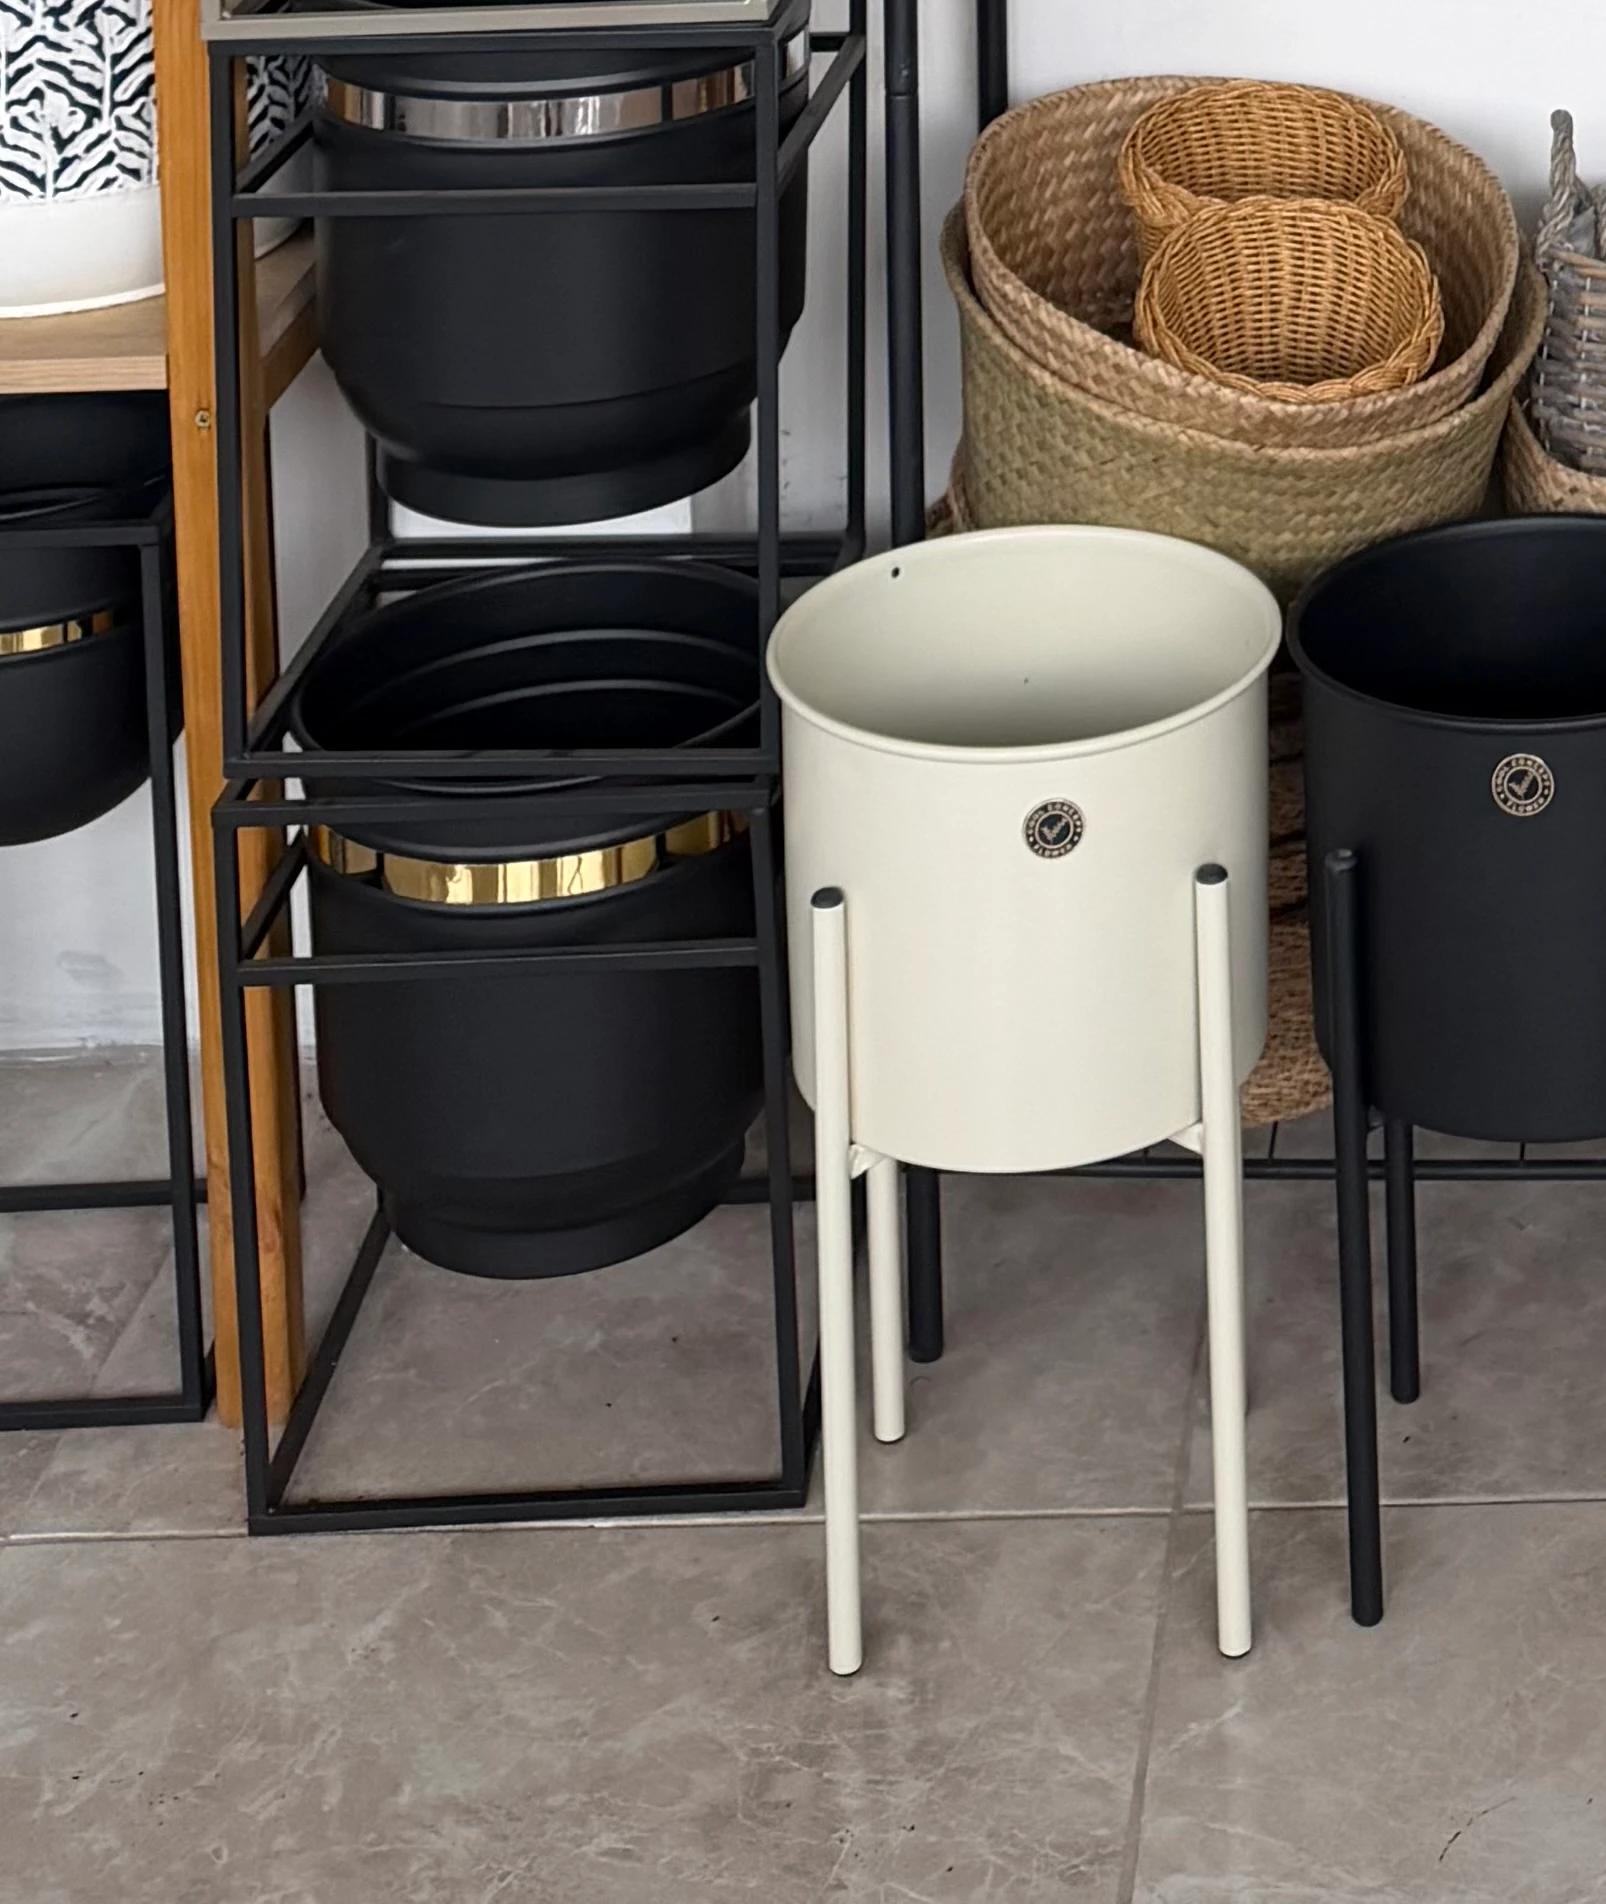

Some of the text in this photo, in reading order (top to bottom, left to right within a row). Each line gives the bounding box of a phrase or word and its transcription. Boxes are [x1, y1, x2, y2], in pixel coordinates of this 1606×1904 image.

[1511, 758, 1550, 786] CONCEPT
[1506, 797, 1544, 812] FLOWER
[1047, 803, 1082, 833] CONCEPT
[1033, 844, 1073, 857] FLOWER
